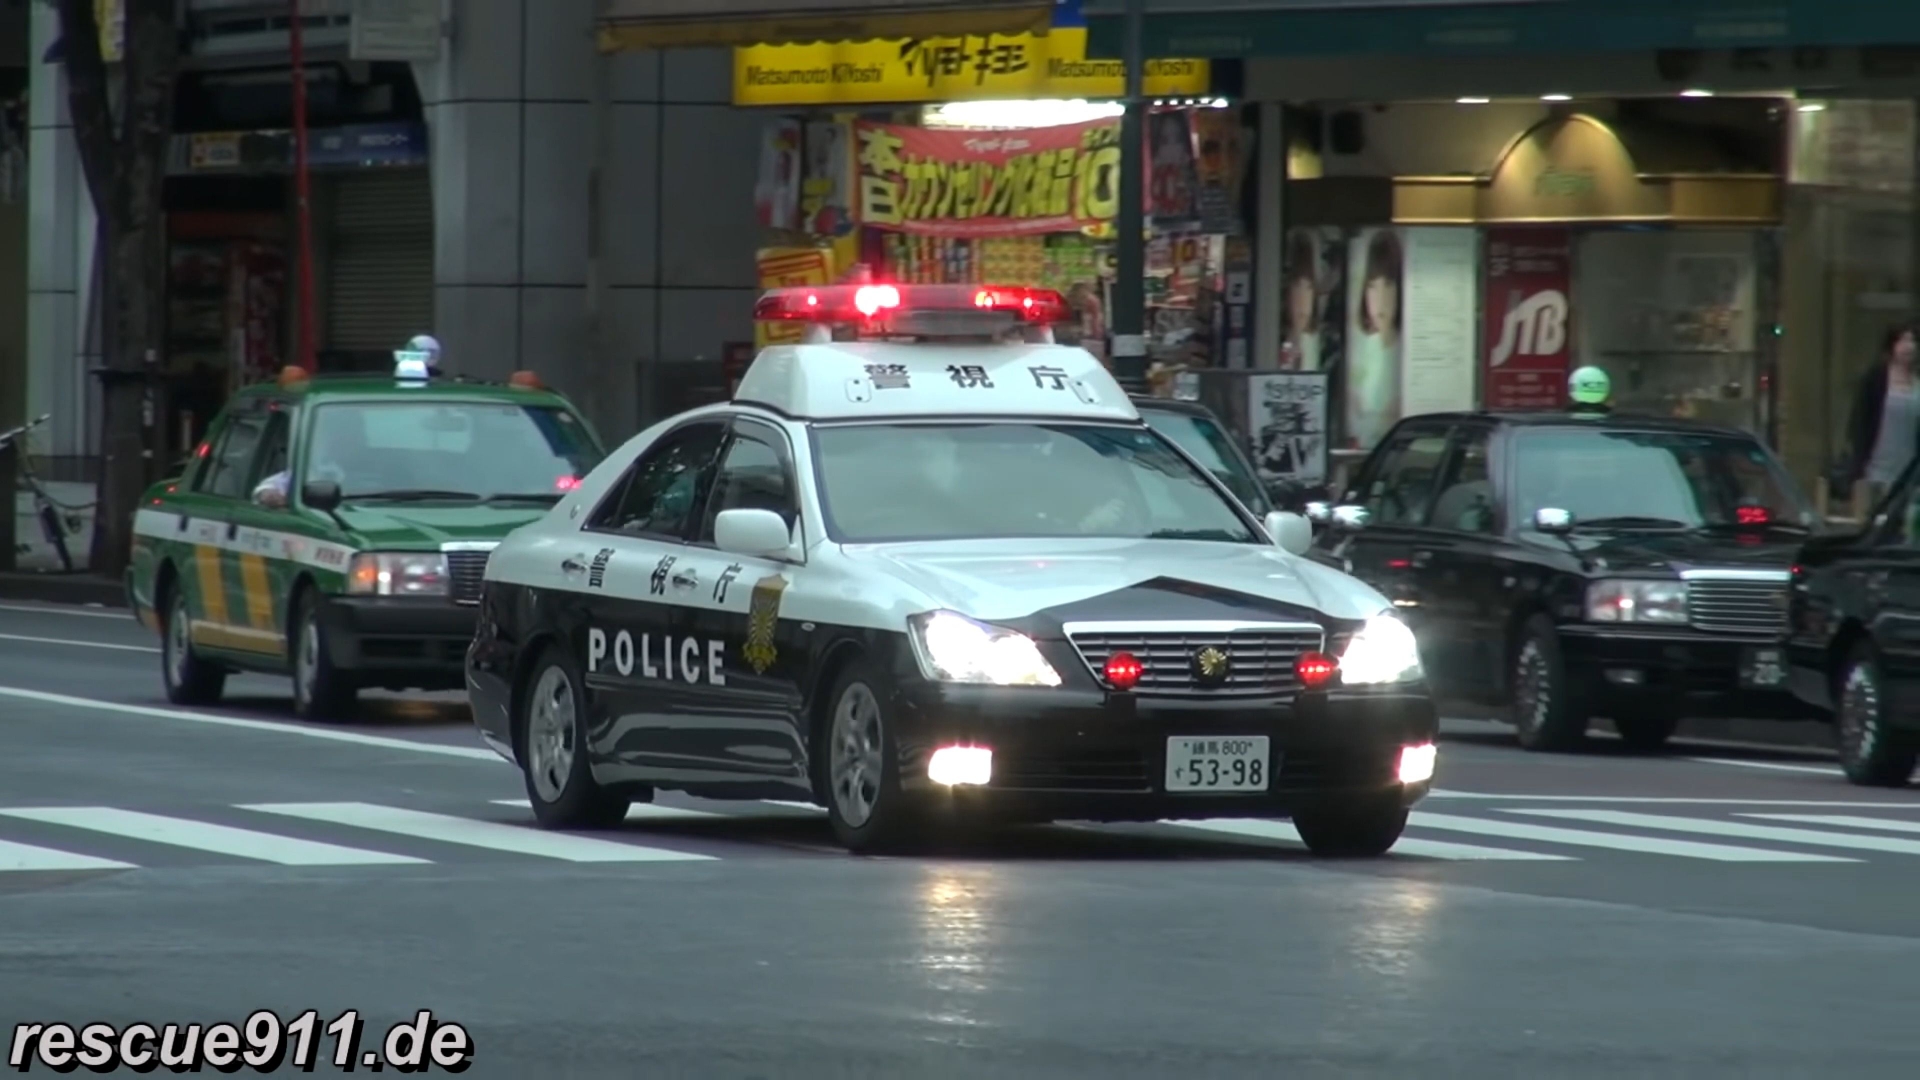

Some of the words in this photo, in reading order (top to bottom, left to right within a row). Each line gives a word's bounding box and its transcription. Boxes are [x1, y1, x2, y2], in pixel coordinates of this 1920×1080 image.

[746, 66, 829, 85] Matsumoto
[858, 129, 903, 223] 本日
[1489, 288, 1568, 368] JTB
[864, 363, 1068, 391] 警視庁
[589, 547, 743, 603] 警視庁
[588, 626, 727, 686] POLICE
[1222, 740, 1248, 755] 800
[1189, 758, 1263, 786] 53-98
